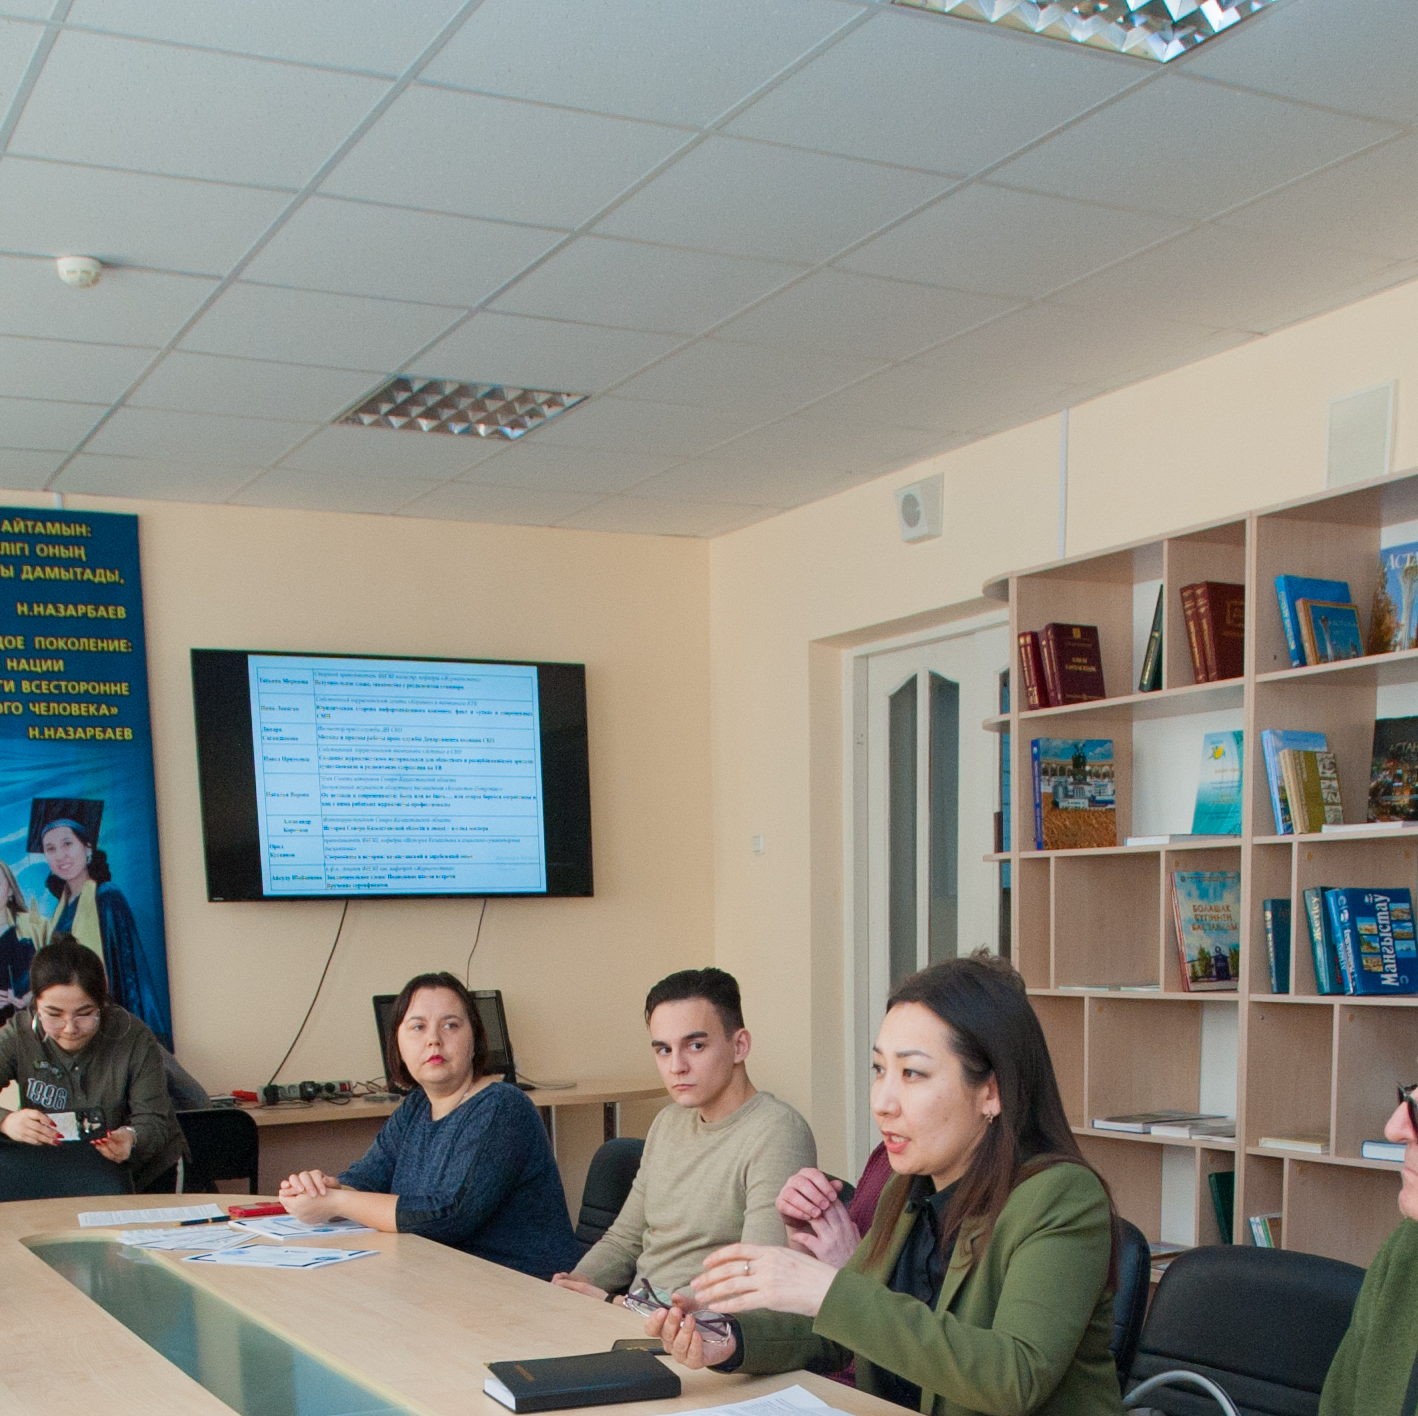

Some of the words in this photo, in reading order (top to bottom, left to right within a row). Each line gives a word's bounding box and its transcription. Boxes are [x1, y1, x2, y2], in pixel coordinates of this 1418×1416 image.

[1, 516, 92, 537] АЙТАМЫН:
[36, 543, 86, 562] ОНЫҢ
[16, 602, 127, 620] Н.НАЗАРБАЕВ
[34, 635, 133, 653] ПОКОЛЕНИЕ:
[6, 658, 65, 674] НАЦИИ
[21, 679, 130, 696] ВСЕСТОРОННЕ
[29, 701, 118, 717] ЧЕЛОВЕКА»
[28, 726, 133, 741] Н.НАЗАРБАЕВ
[27, 1078, 68, 1110] 1996
